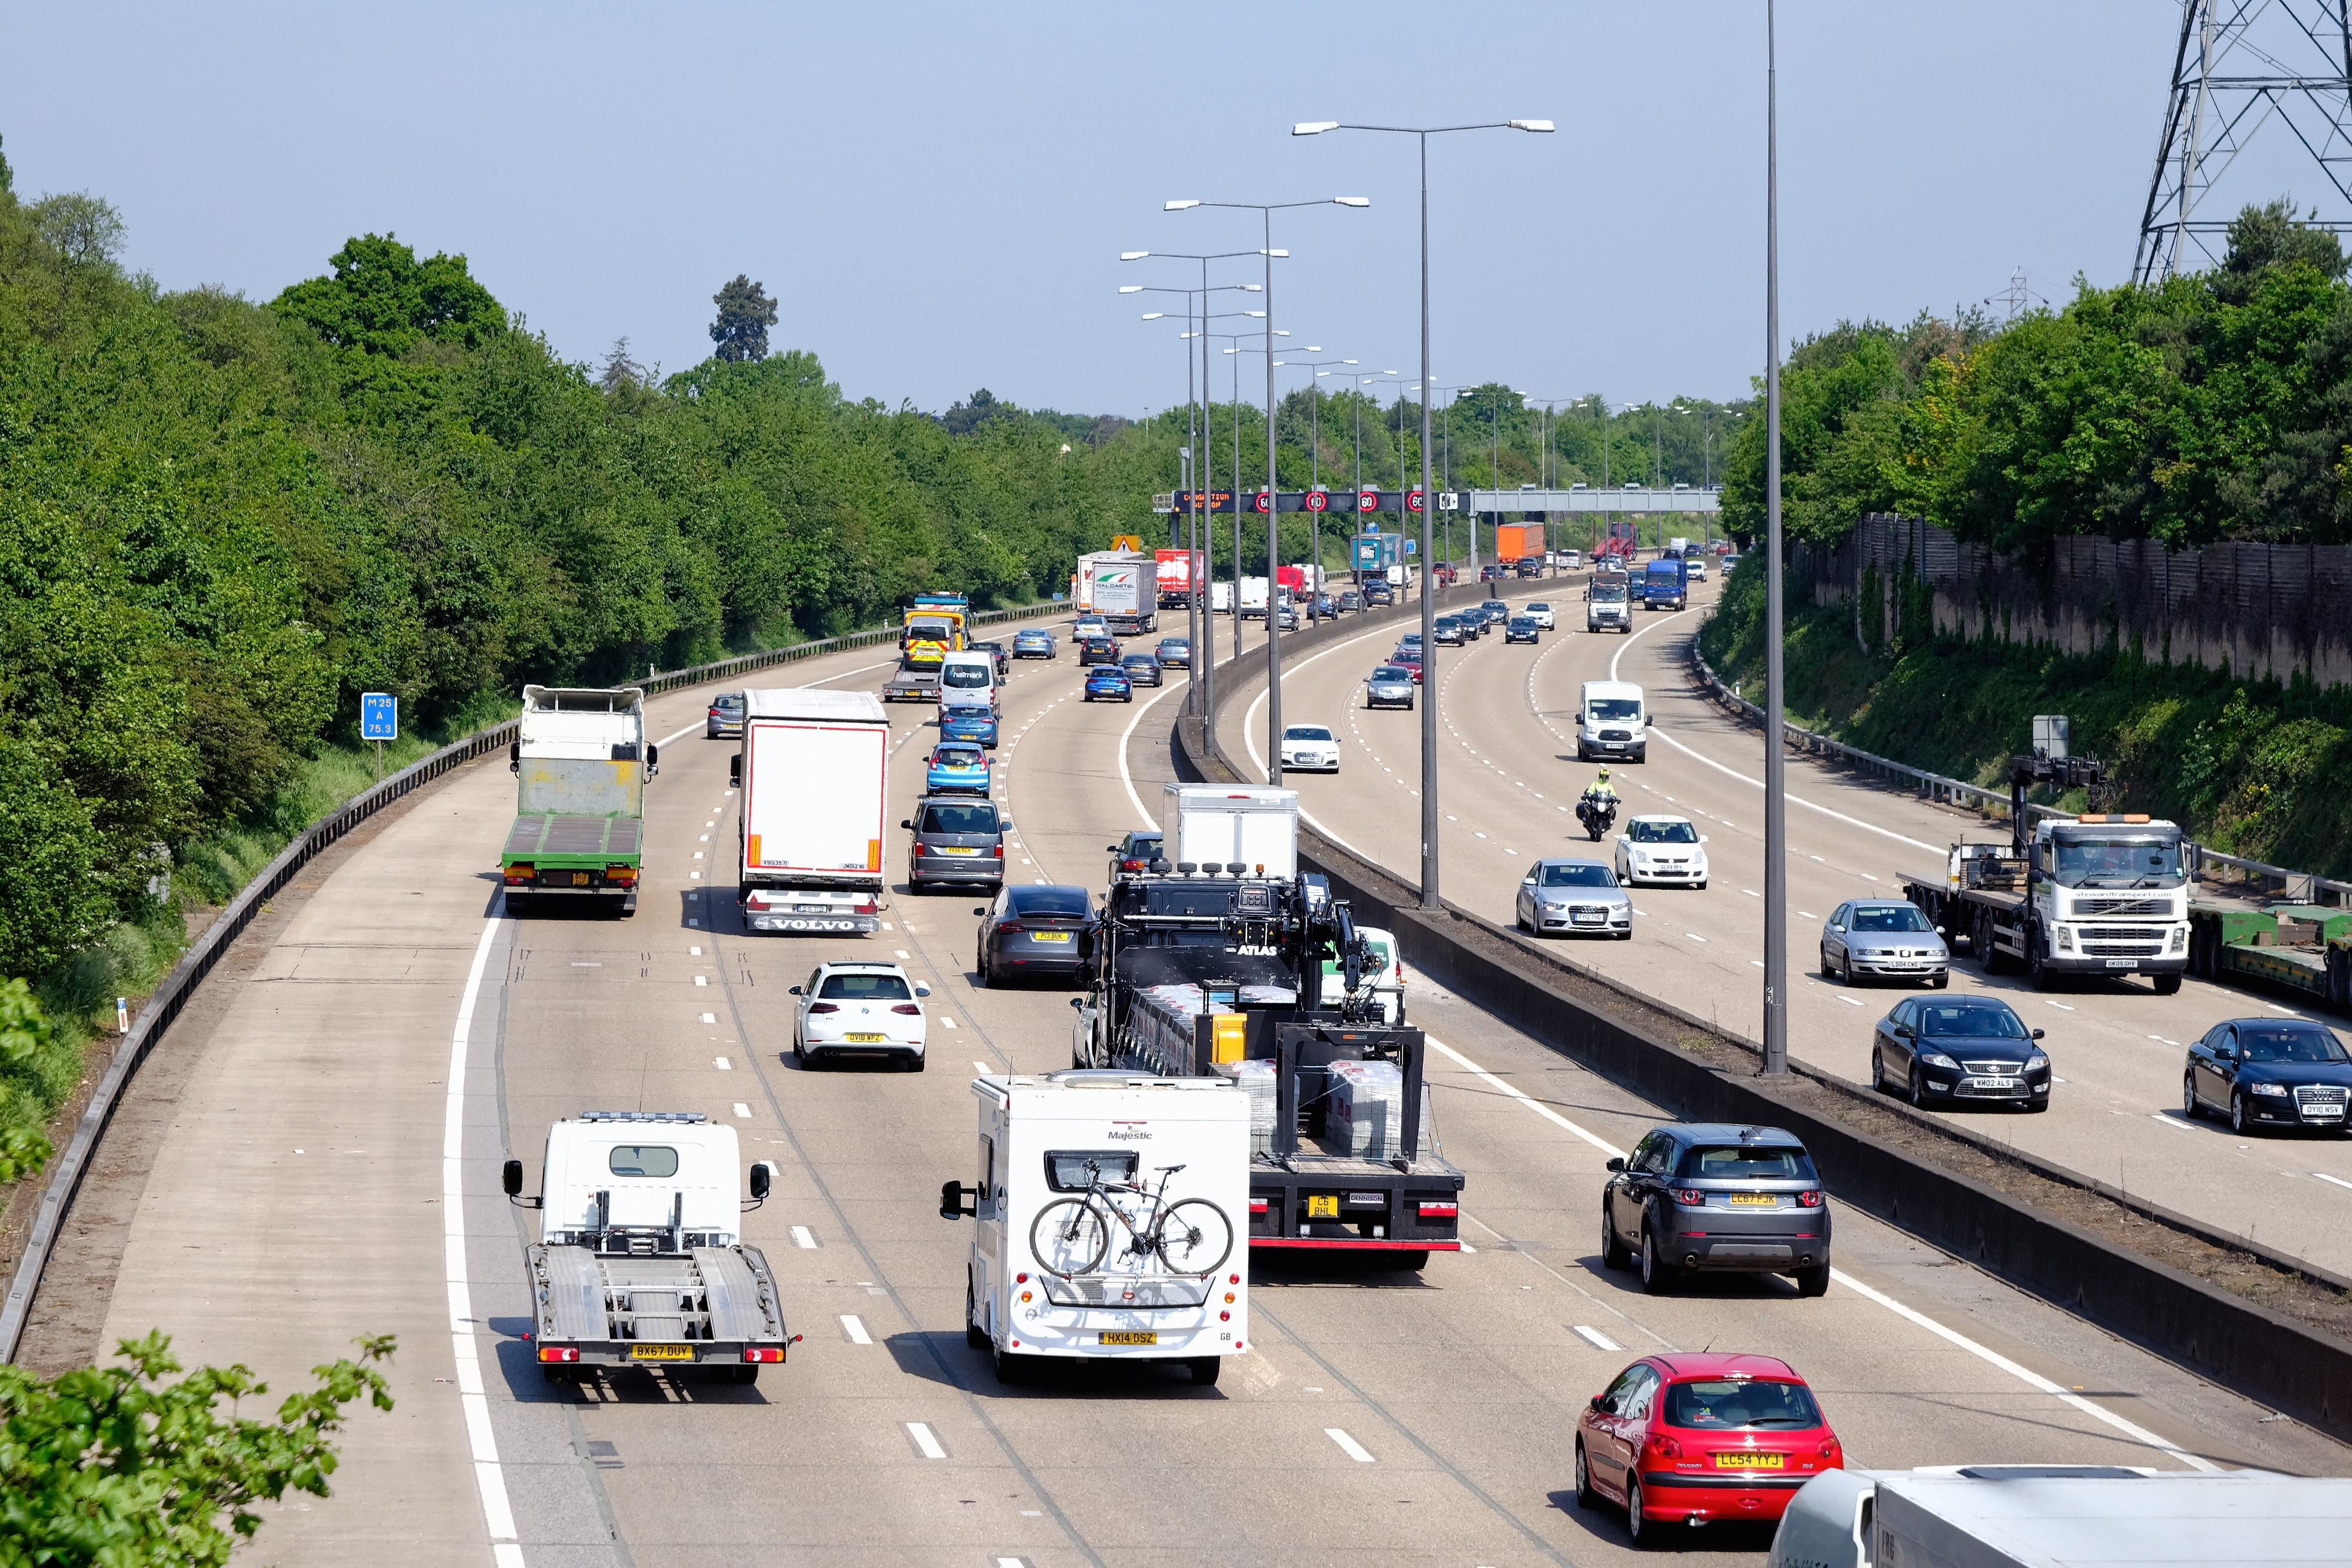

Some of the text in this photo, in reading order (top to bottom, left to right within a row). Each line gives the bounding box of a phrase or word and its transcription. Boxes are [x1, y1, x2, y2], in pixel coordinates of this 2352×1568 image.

[1362, 497, 1373, 507] 60
[376, 711, 383, 720] A
[369, 724, 391, 733] 75.3
[771, 918, 855, 930] VOLVO
[1238, 945, 1276, 956] ATLAS
[1108, 1131, 1153, 1141] Majestic
[1318, 1197, 1328, 1206] C6
[1731, 1195, 1774, 1203] LC67 FJK
[1315, 1206, 1331, 1215] BHL
[1108, 1333, 1153, 1343] HX14 DSZ
[637, 1346, 688, 1356] BX67 DUY
[1721, 1454, 1779, 1465] LC54 YYJ
